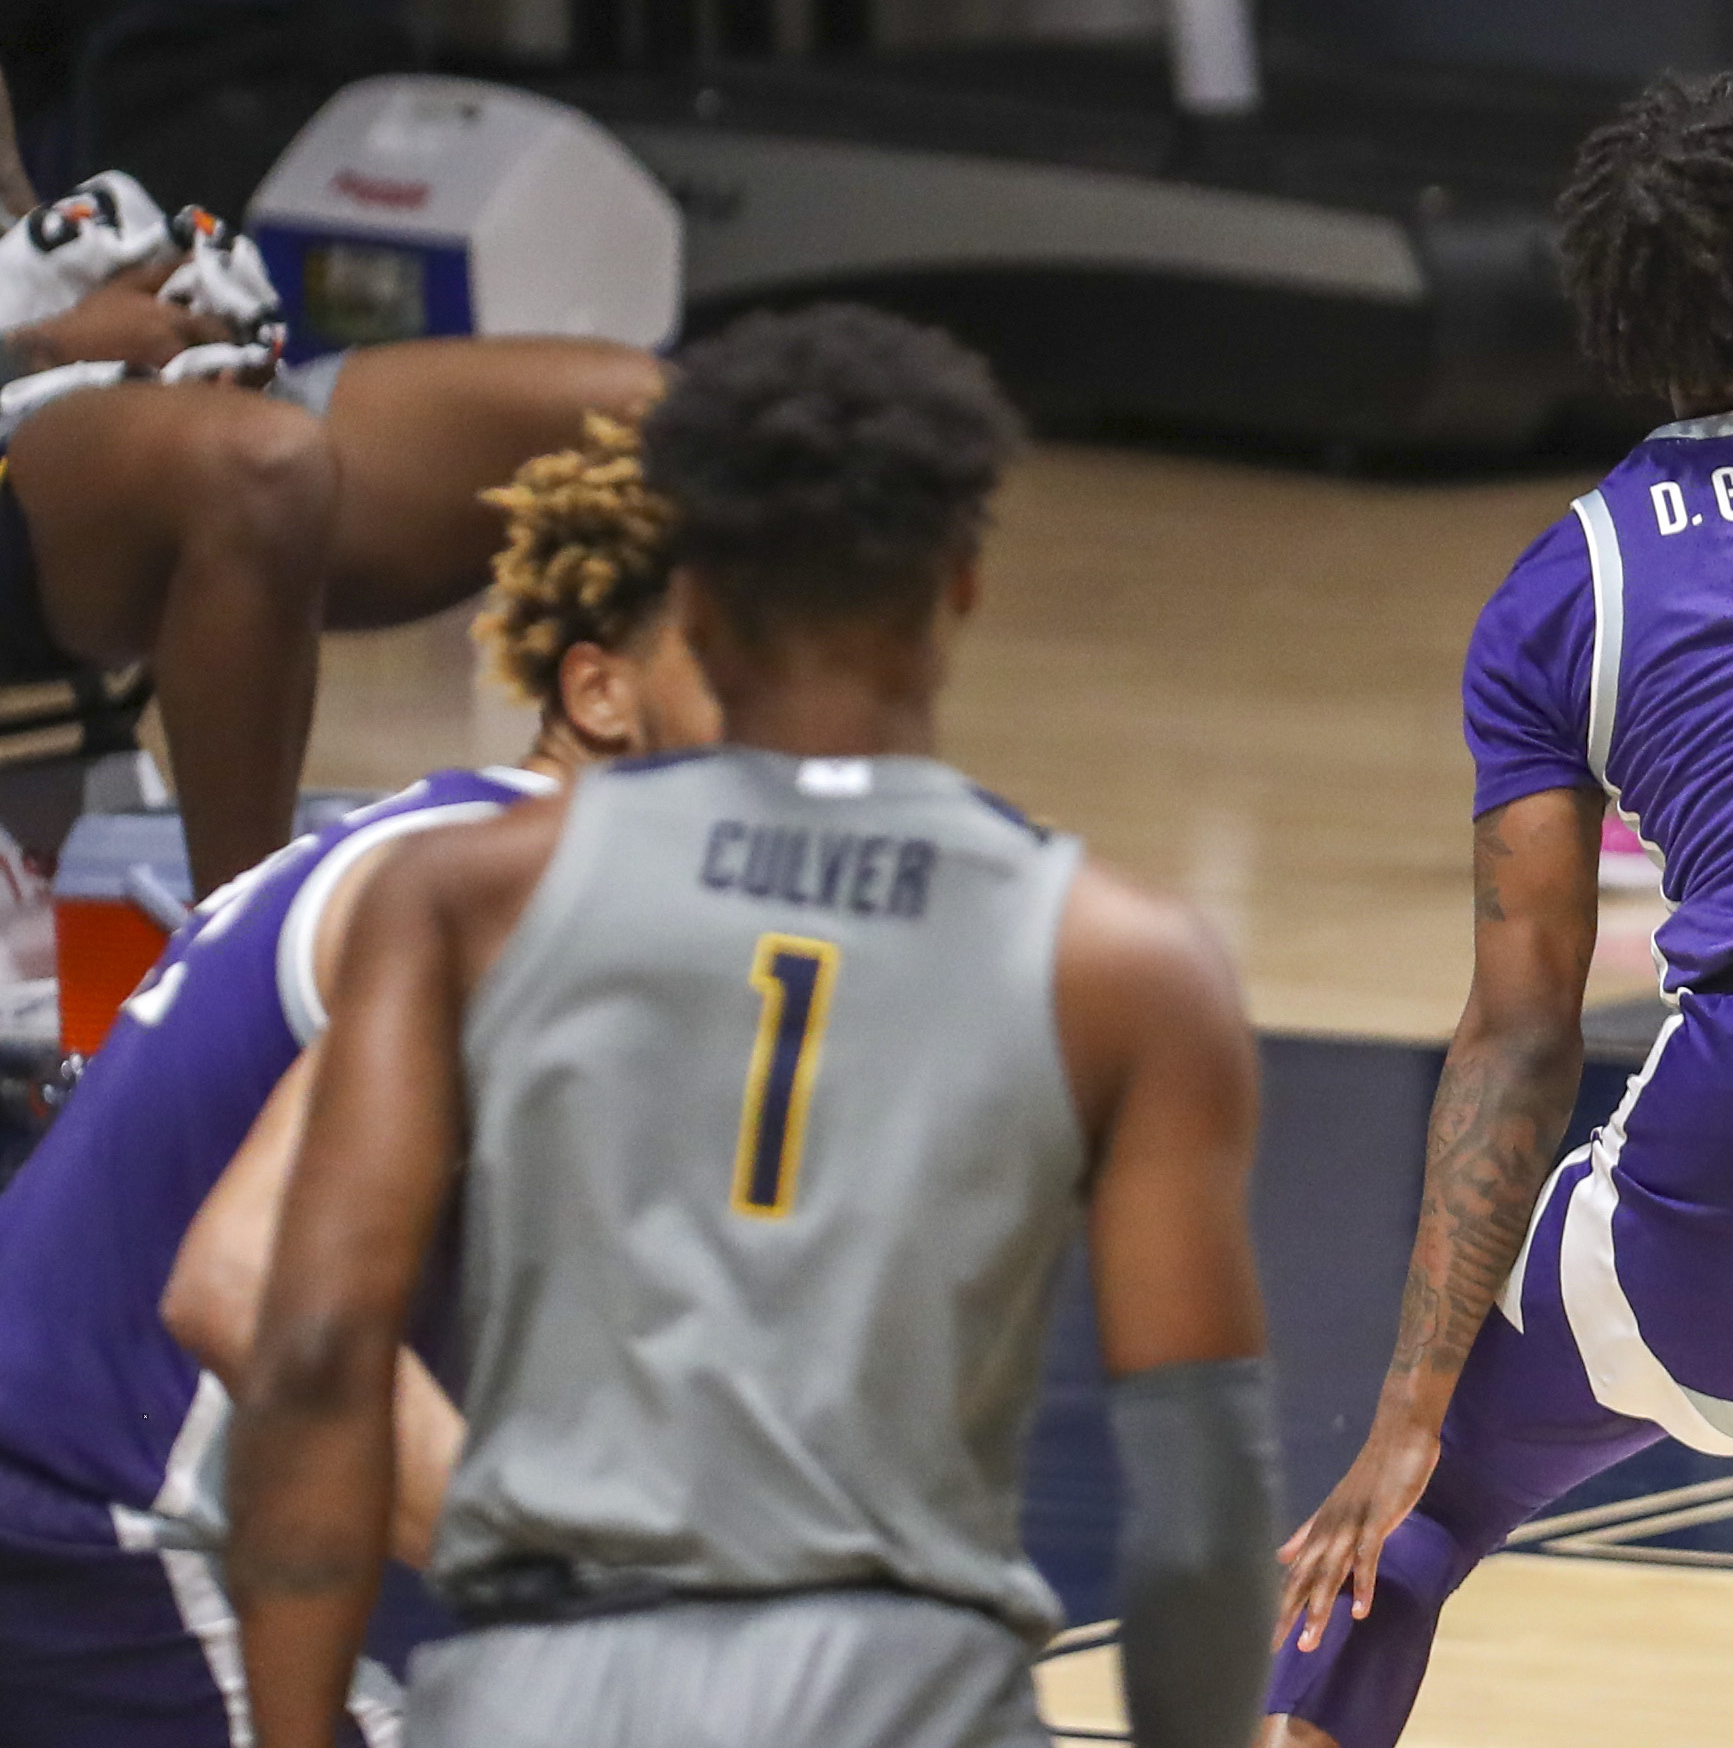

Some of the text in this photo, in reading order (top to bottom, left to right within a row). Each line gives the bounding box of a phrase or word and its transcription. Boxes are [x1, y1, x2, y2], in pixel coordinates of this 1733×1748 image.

[1650, 481, 1703, 537] D.
[701, 818, 941, 920] CULVER
[729, 931, 843, 1220] 1
